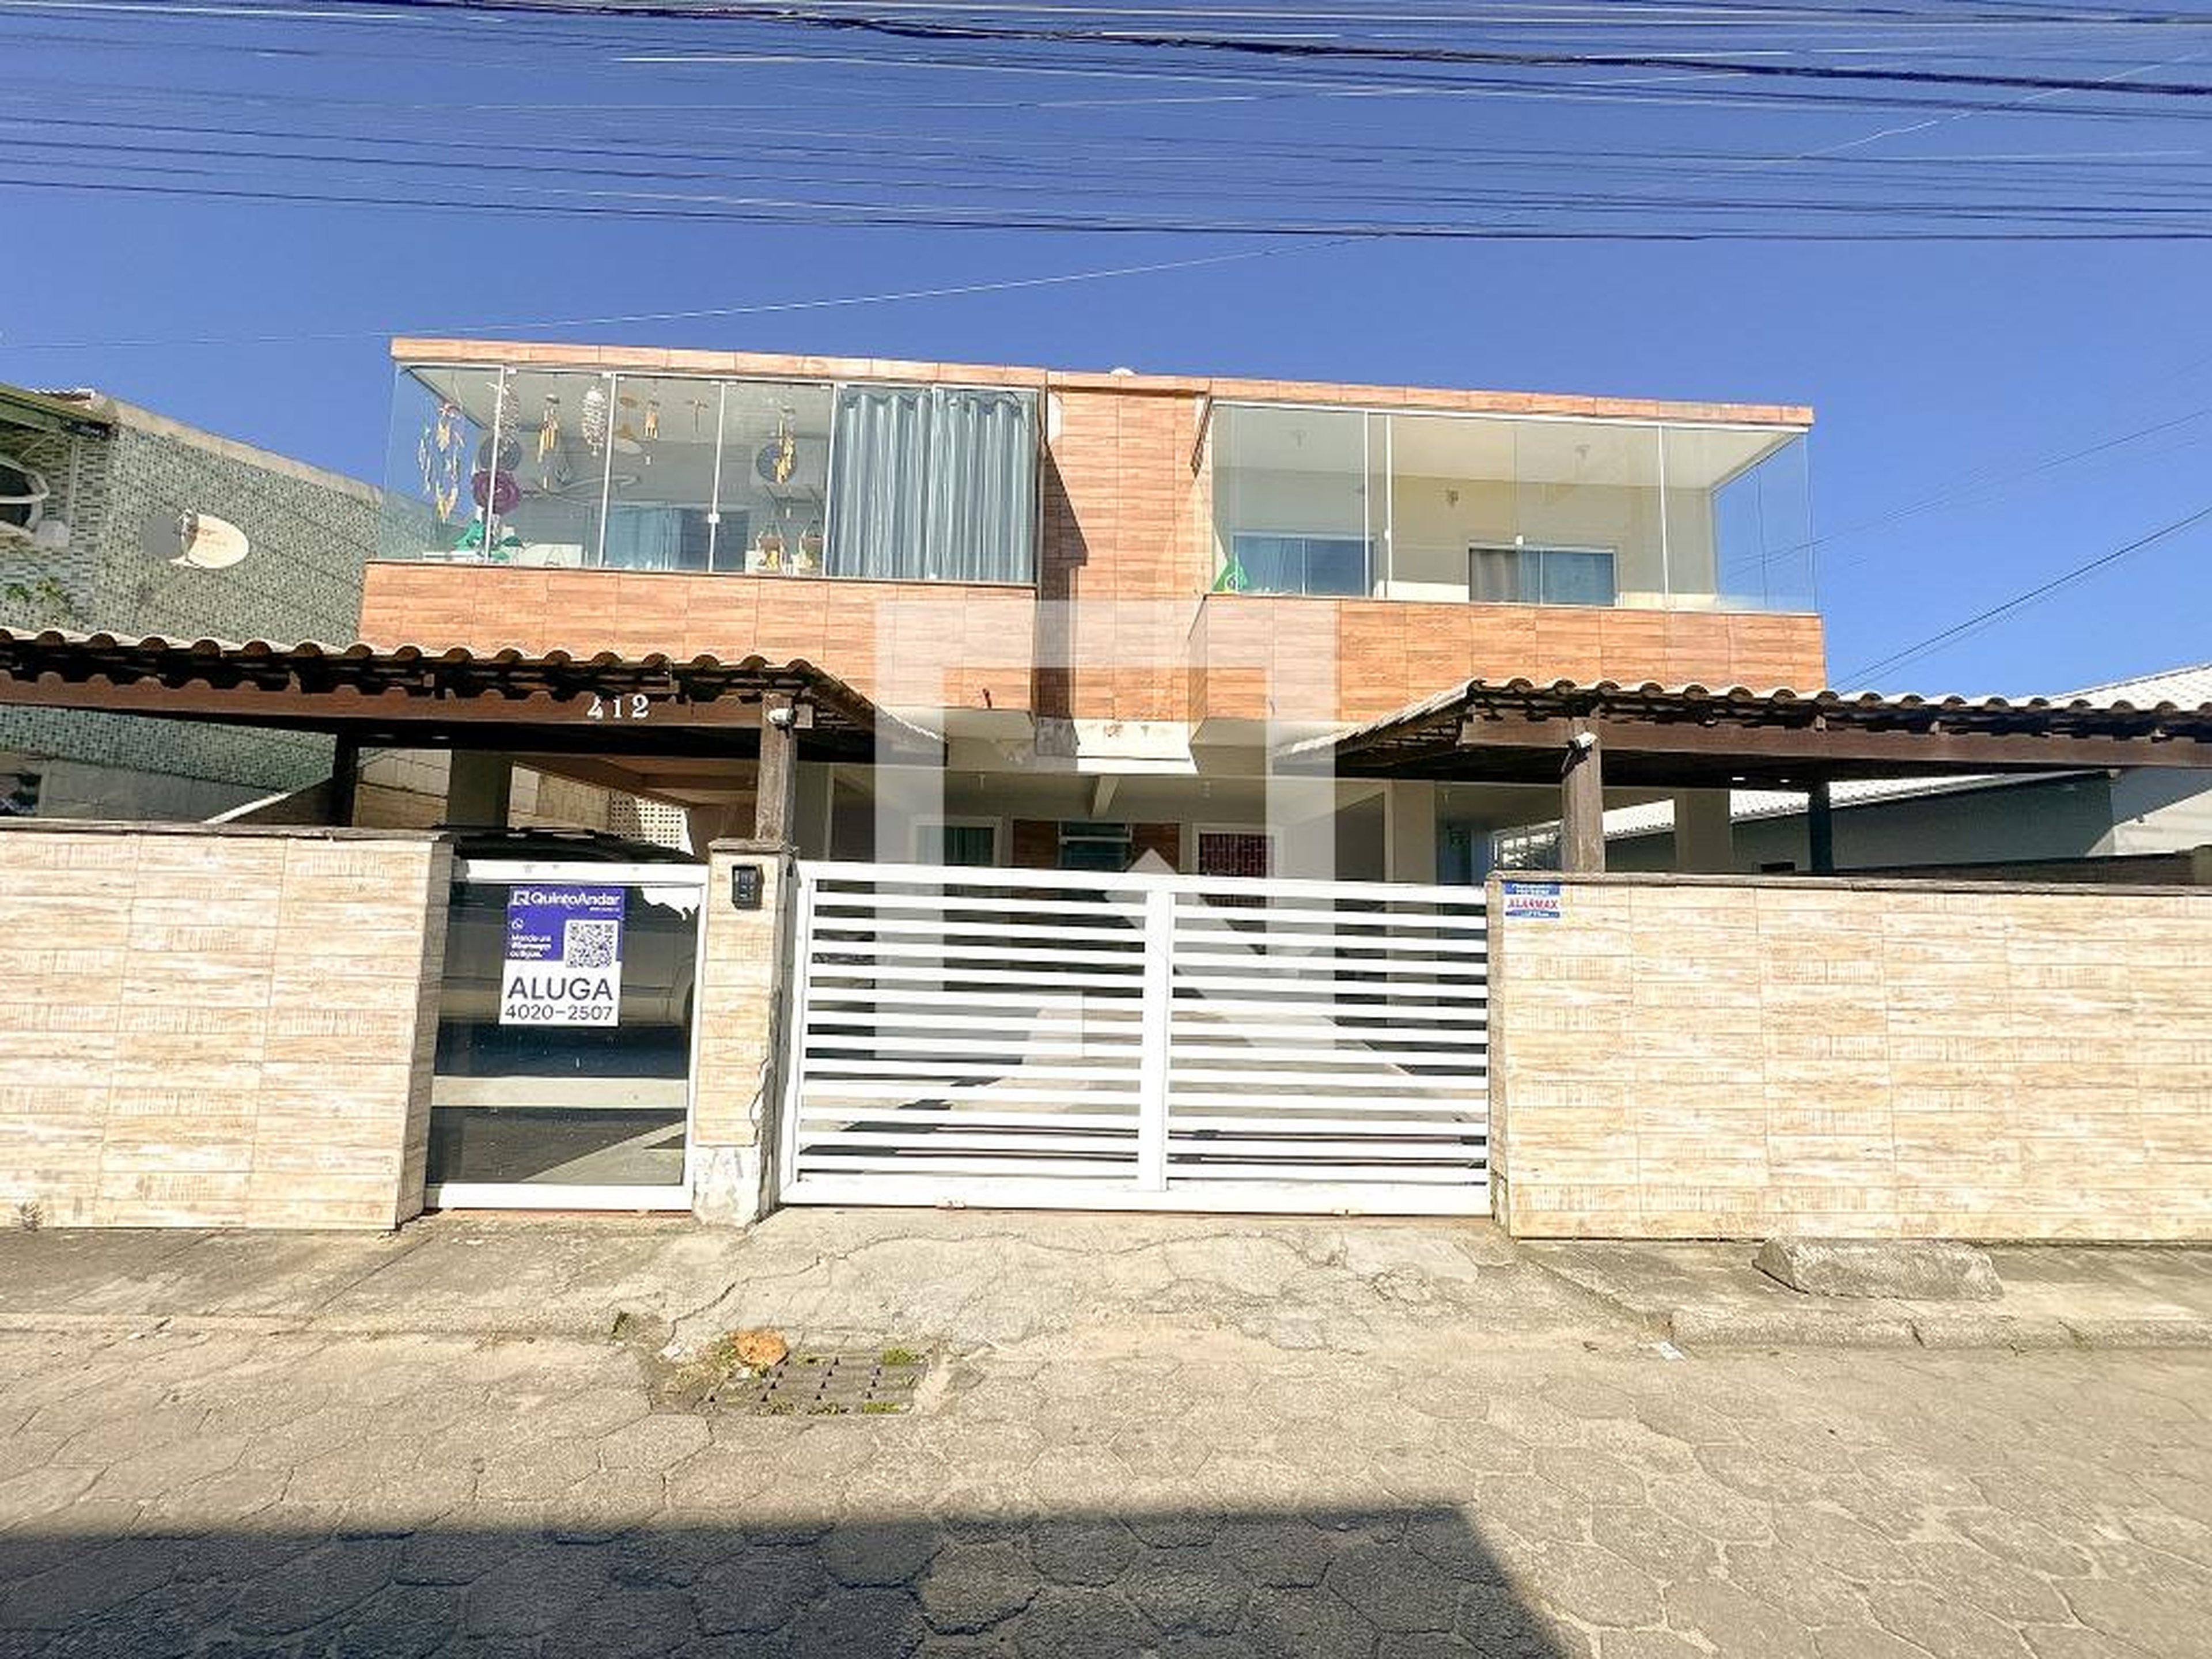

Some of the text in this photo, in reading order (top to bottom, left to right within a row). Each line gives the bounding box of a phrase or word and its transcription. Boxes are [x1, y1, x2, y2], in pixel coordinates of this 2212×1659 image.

[587, 694, 649, 719] 412
[531, 892, 620, 909] QuintoAndar
[507, 977, 613, 1001] ALUGA
[505, 1004, 613, 1020] 4020-2507
